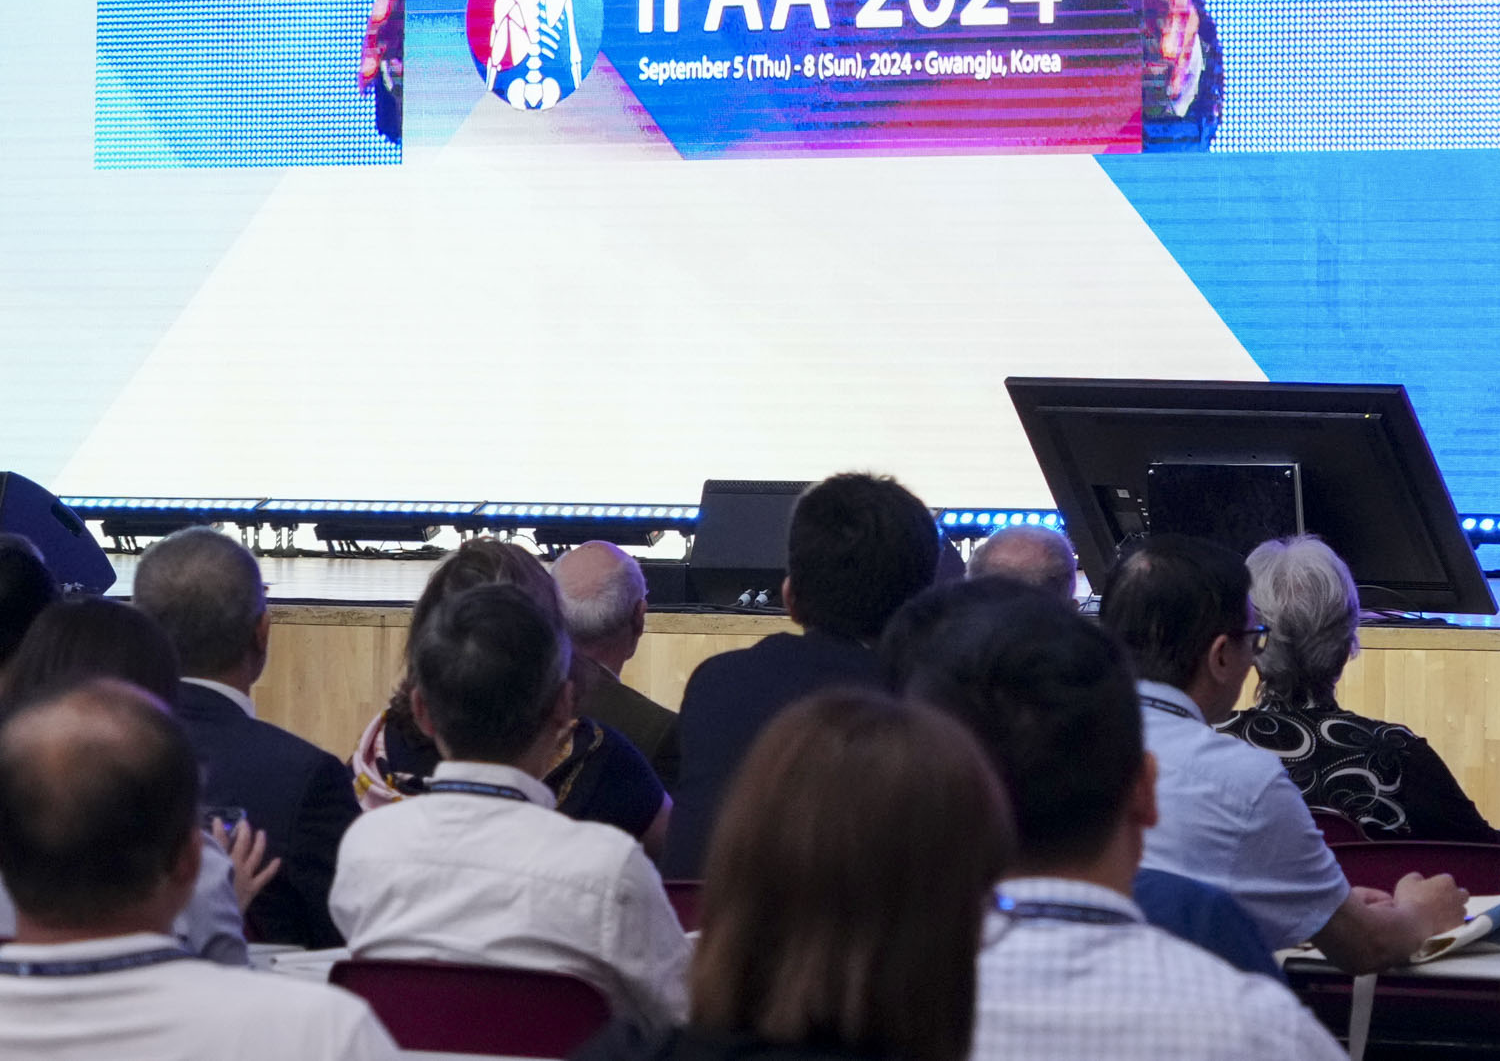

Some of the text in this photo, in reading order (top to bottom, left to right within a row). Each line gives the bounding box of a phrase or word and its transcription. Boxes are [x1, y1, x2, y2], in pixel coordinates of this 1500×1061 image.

[639, 55, 731, 86] September
[733, 55, 744, 79] 5
[747, 53, 791, 81] (Thu)
[803, 54, 815, 77] 8
[818, 52, 867, 79] (Sun),
[869, 52, 912, 76] 2024
[924, 50, 1007, 80] Gwangju,
[1010, 49, 1062, 73] Korea
